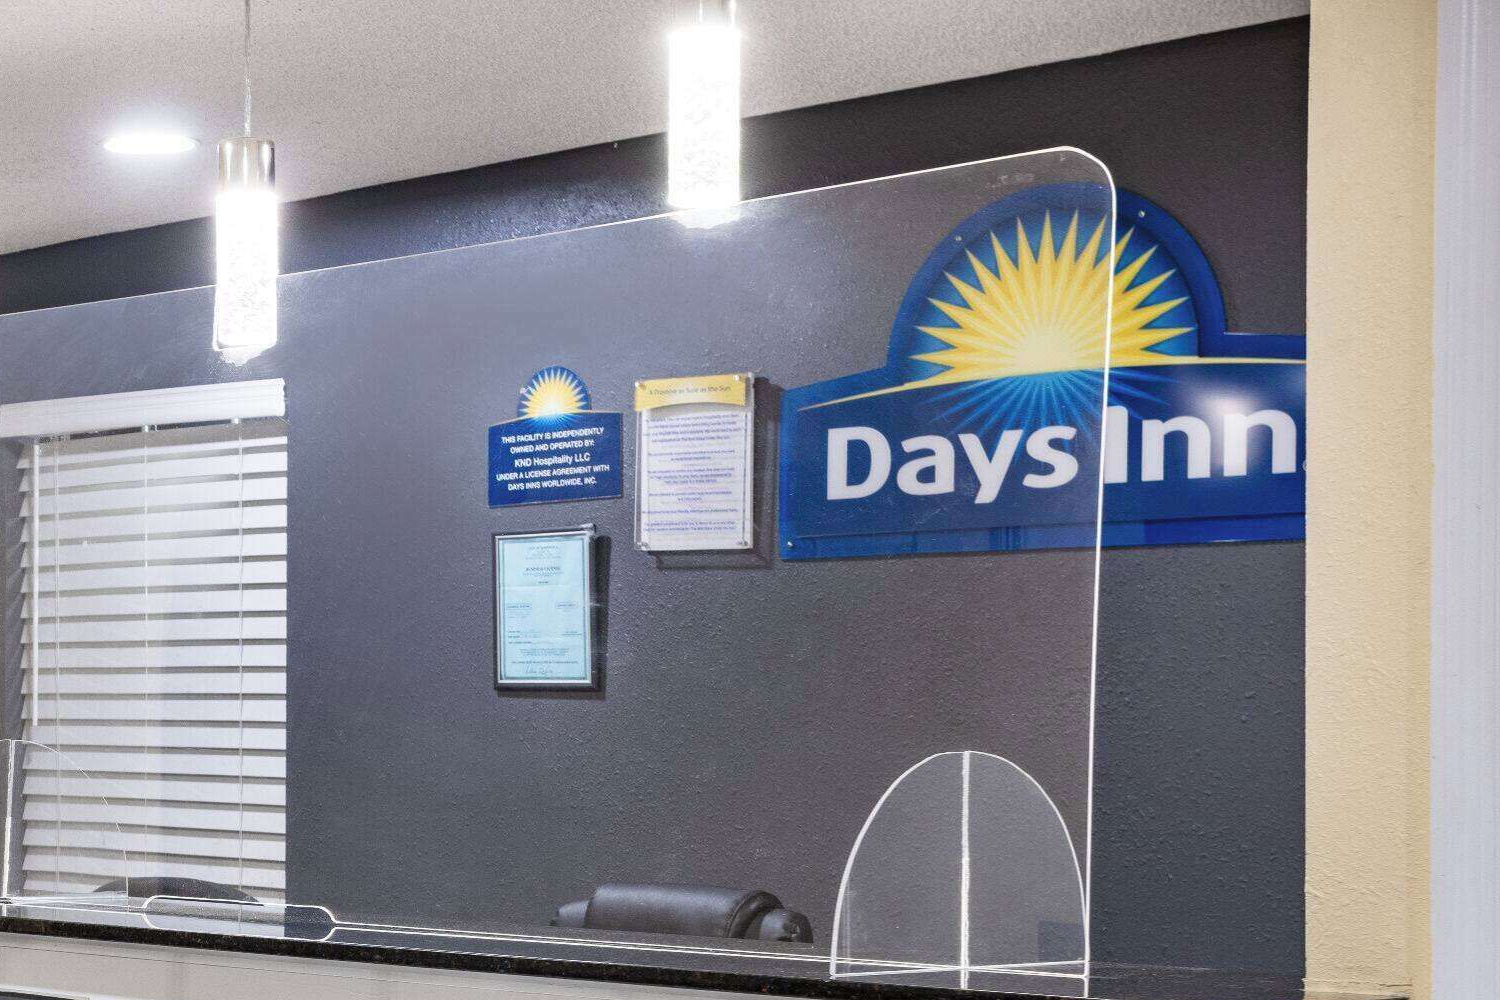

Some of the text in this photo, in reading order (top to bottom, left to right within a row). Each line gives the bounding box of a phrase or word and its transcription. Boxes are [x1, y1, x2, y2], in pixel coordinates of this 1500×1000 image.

[501, 436, 516, 444] THIS
[516, 433, 544, 442] FACILITY
[551, 427, 604, 439] INDEPENDENTLY
[510, 439, 595, 454] OWNED AND OPERATED BY:
[514, 452, 591, 468] KND Hospitality LLC
[826, 406, 1298, 504] Days Inn
[496, 472, 519, 481] UNDER
[524, 469, 552, 479] LICENSE
[552, 466, 591, 476] AGREEMENT
[592, 464, 610, 472] WITH
[507, 476, 597, 491] DAYS INNS WORLDWIDE, INC.
